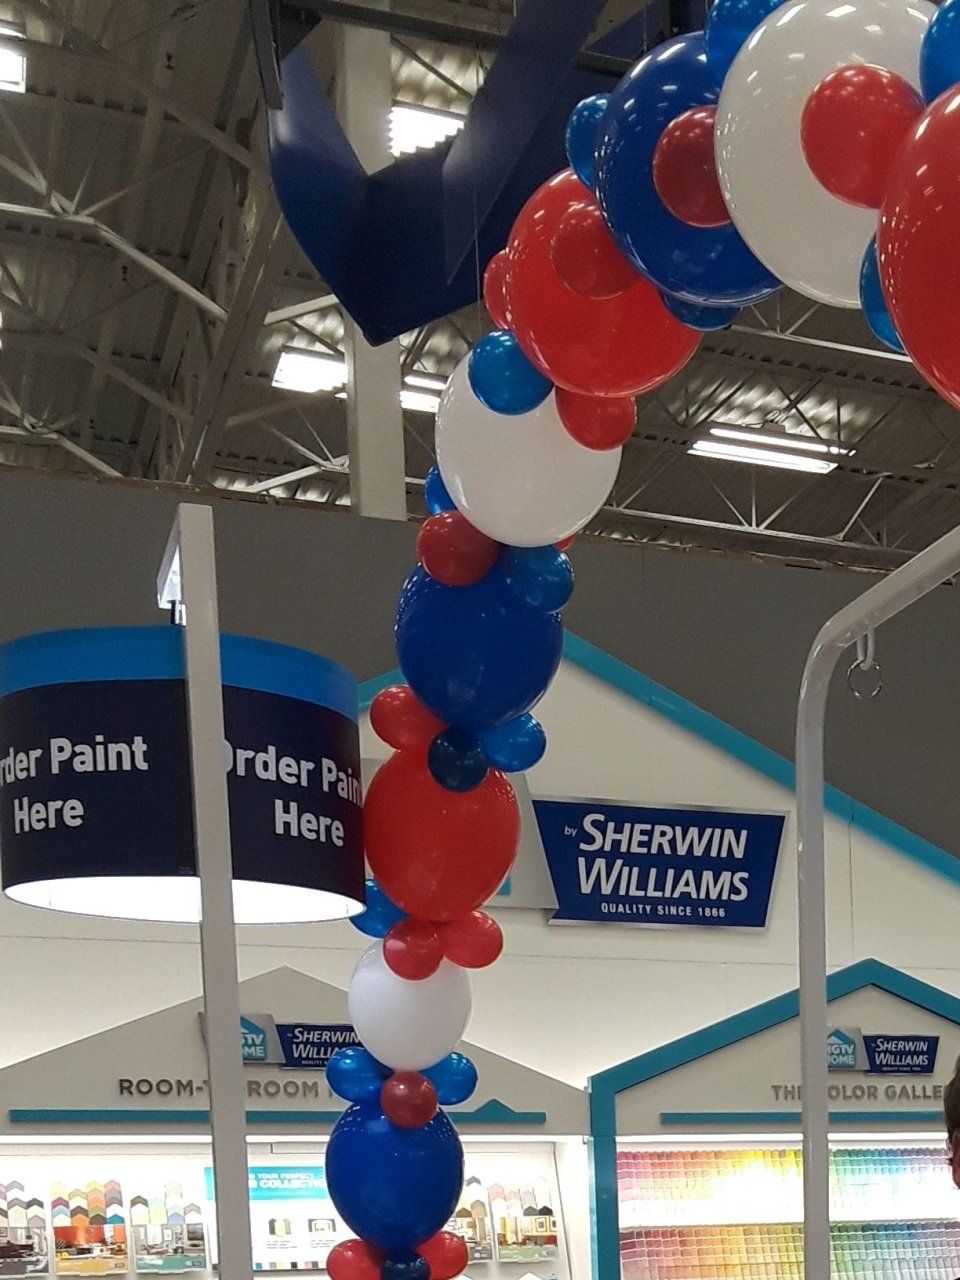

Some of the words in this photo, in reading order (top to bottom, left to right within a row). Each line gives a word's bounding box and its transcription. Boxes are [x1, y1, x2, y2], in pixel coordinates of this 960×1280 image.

[0, 747, 42, 787] rder
[50, 735, 149, 775] Paint
[321, 757, 361, 806] Pain
[14, 796, 84, 834] Here
[274, 798, 345, 848] Here
[564, 825, 577, 837] by
[579, 813, 748, 859] SHERWIN
[577, 856, 749, 901] WILLIAMS
[601, 902, 652, 915] QUALITY
[657, 905, 692, 916] SINCE
[697, 907, 726, 918] 1866
[827, 1084, 879, 1100] OLOR
